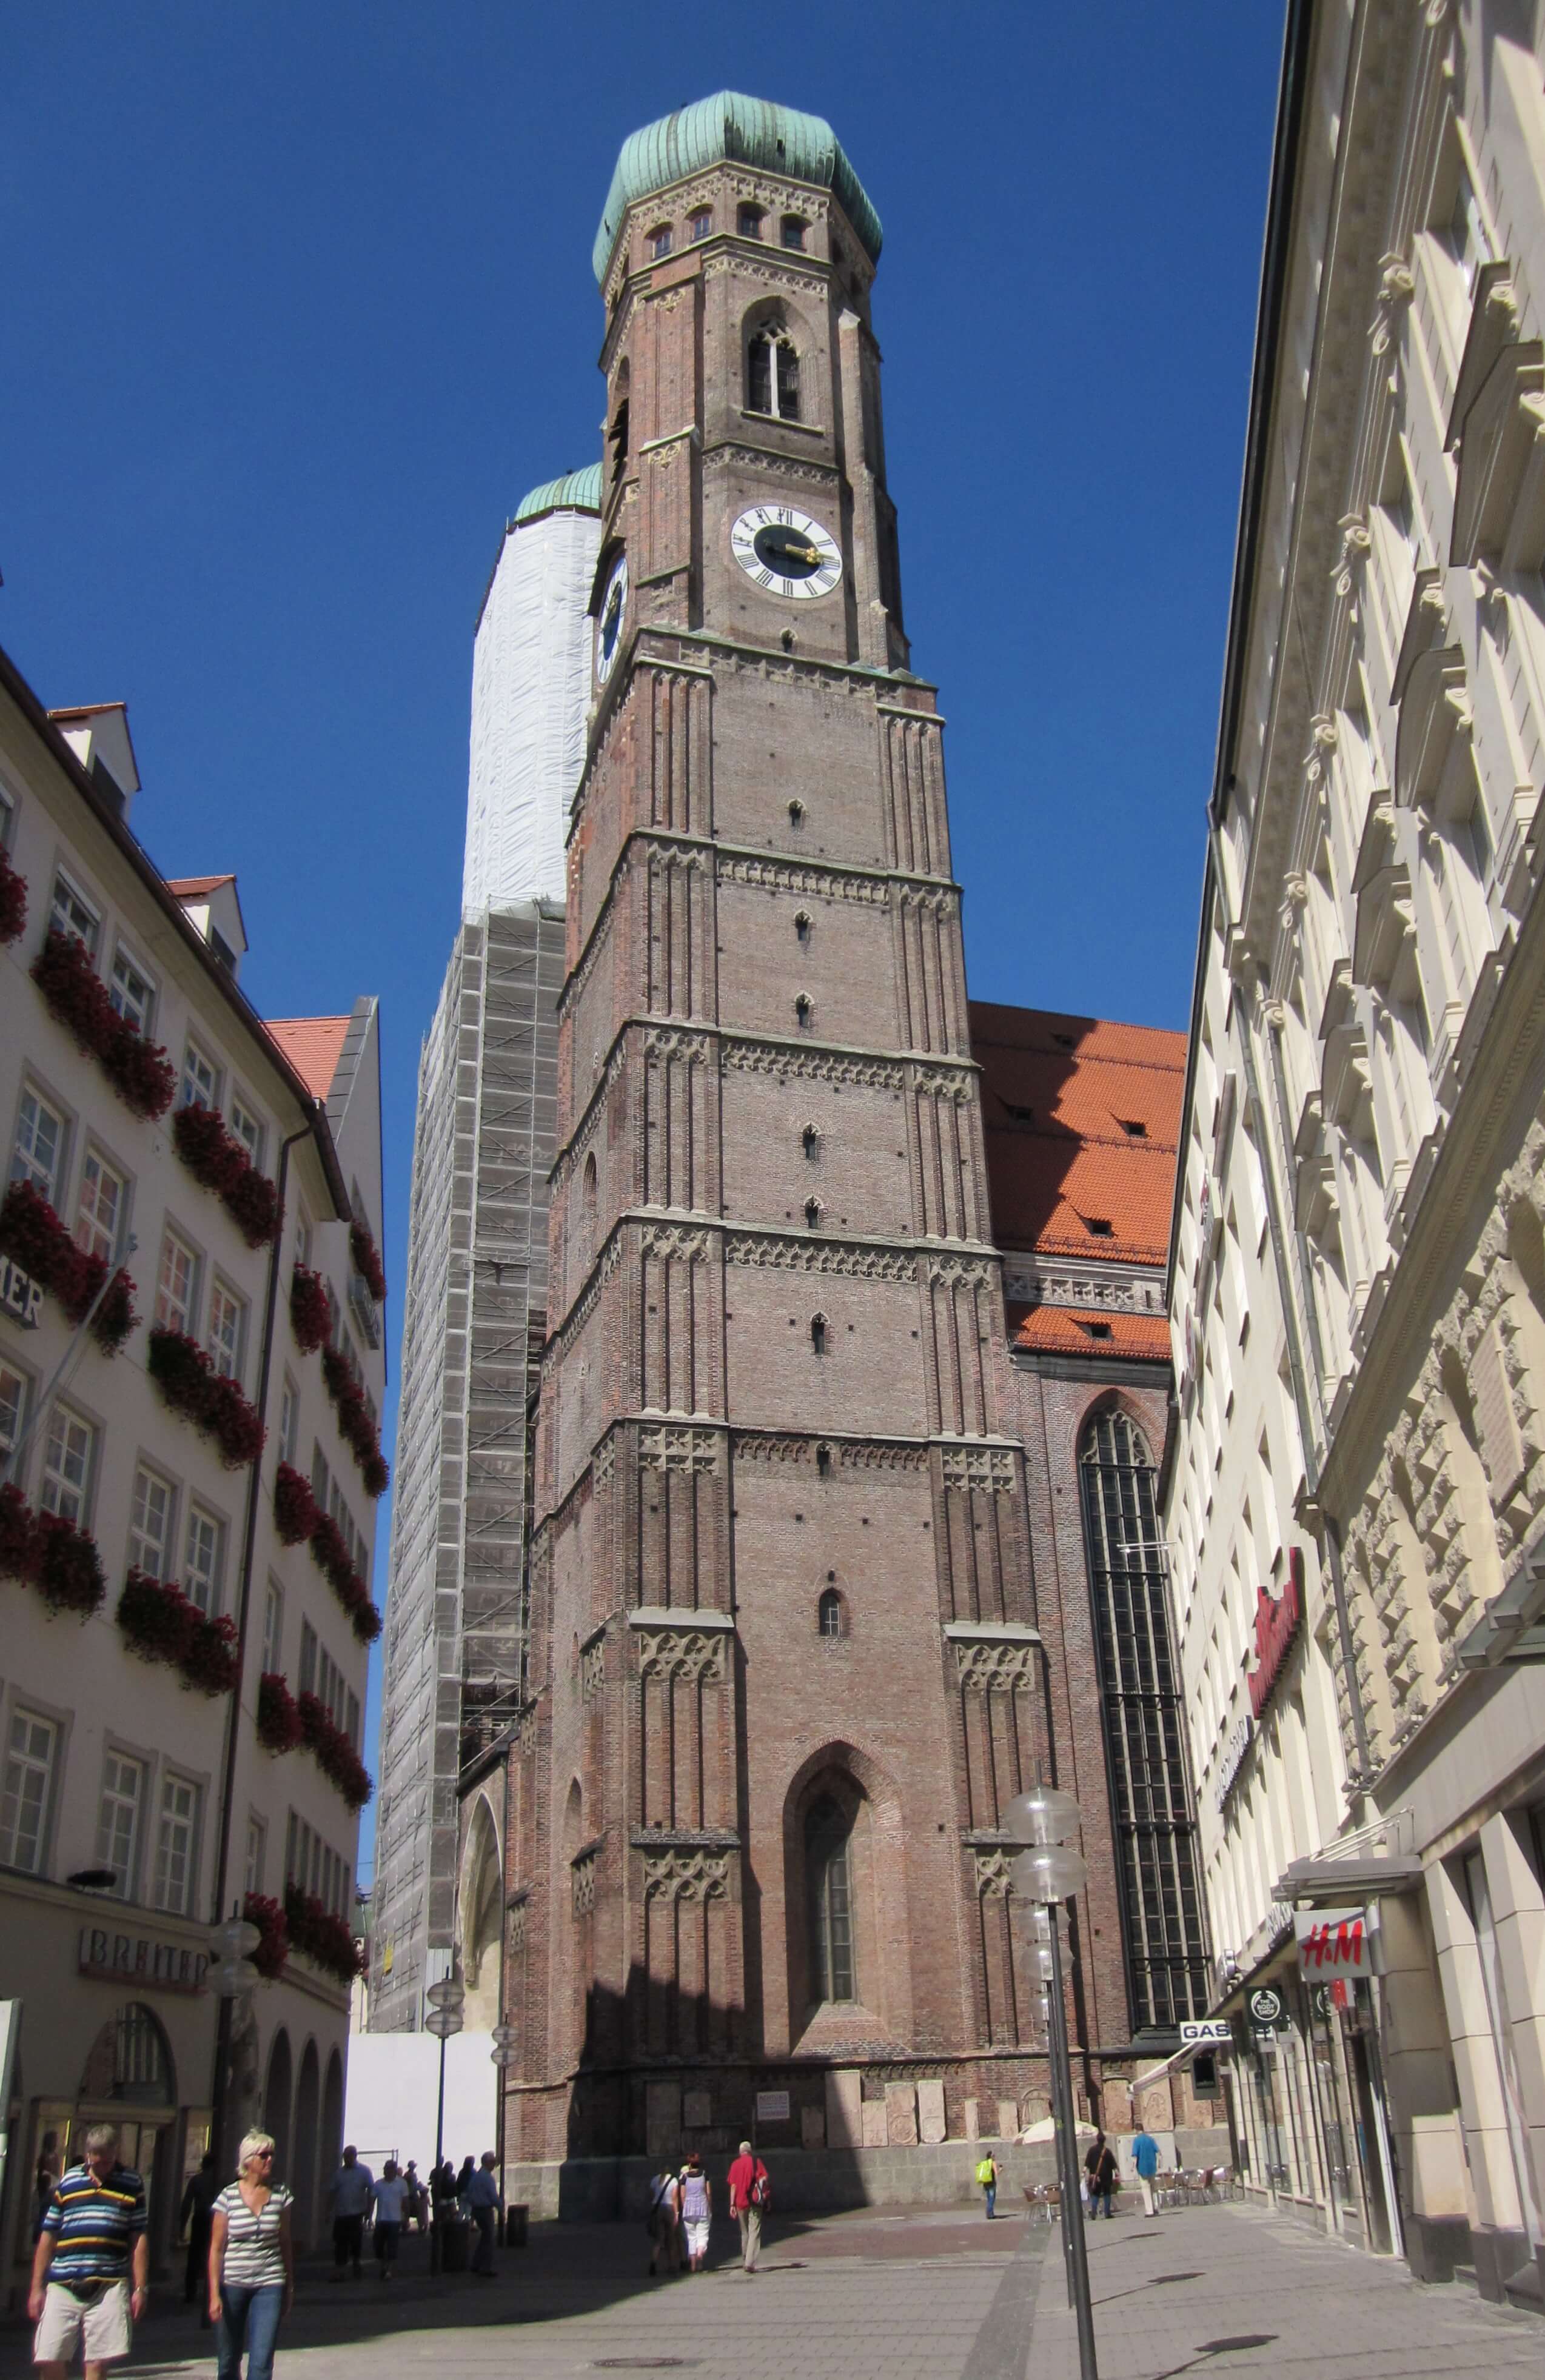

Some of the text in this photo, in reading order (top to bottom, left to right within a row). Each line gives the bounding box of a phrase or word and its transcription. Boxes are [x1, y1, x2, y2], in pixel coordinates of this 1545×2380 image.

[803, 521, 813, 532] I
[815, 538, 834, 547] II
[1302, 1919, 1363, 1970] H&M
[1183, 2023, 1232, 2039] GAS
